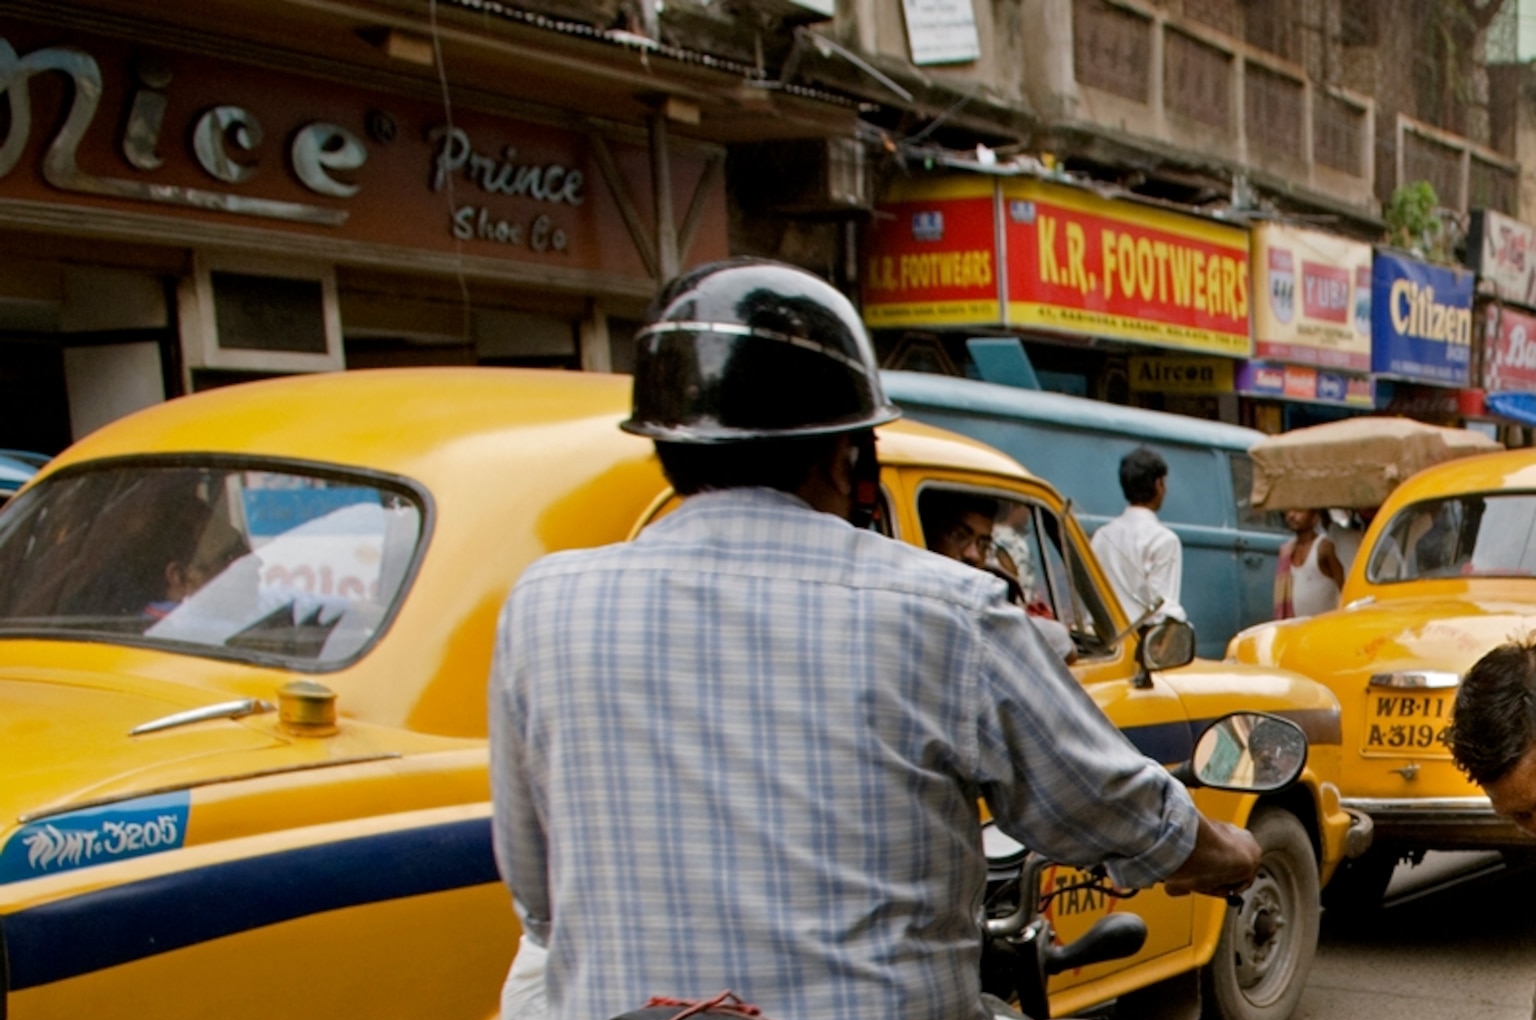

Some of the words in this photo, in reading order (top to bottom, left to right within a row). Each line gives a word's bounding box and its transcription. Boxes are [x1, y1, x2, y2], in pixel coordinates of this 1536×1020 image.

[429, 125, 586, 206] Prince
[452, 204, 524, 245] Shoe
[900, 250, 992, 291] FOOTWEARS
[1036, 214, 1097, 296] K.R.
[1101, 229, 1248, 323] FOOTWEARS
[1390, 277, 1472, 346] Citizen
[1055, 873, 1105, 917] TAXI
